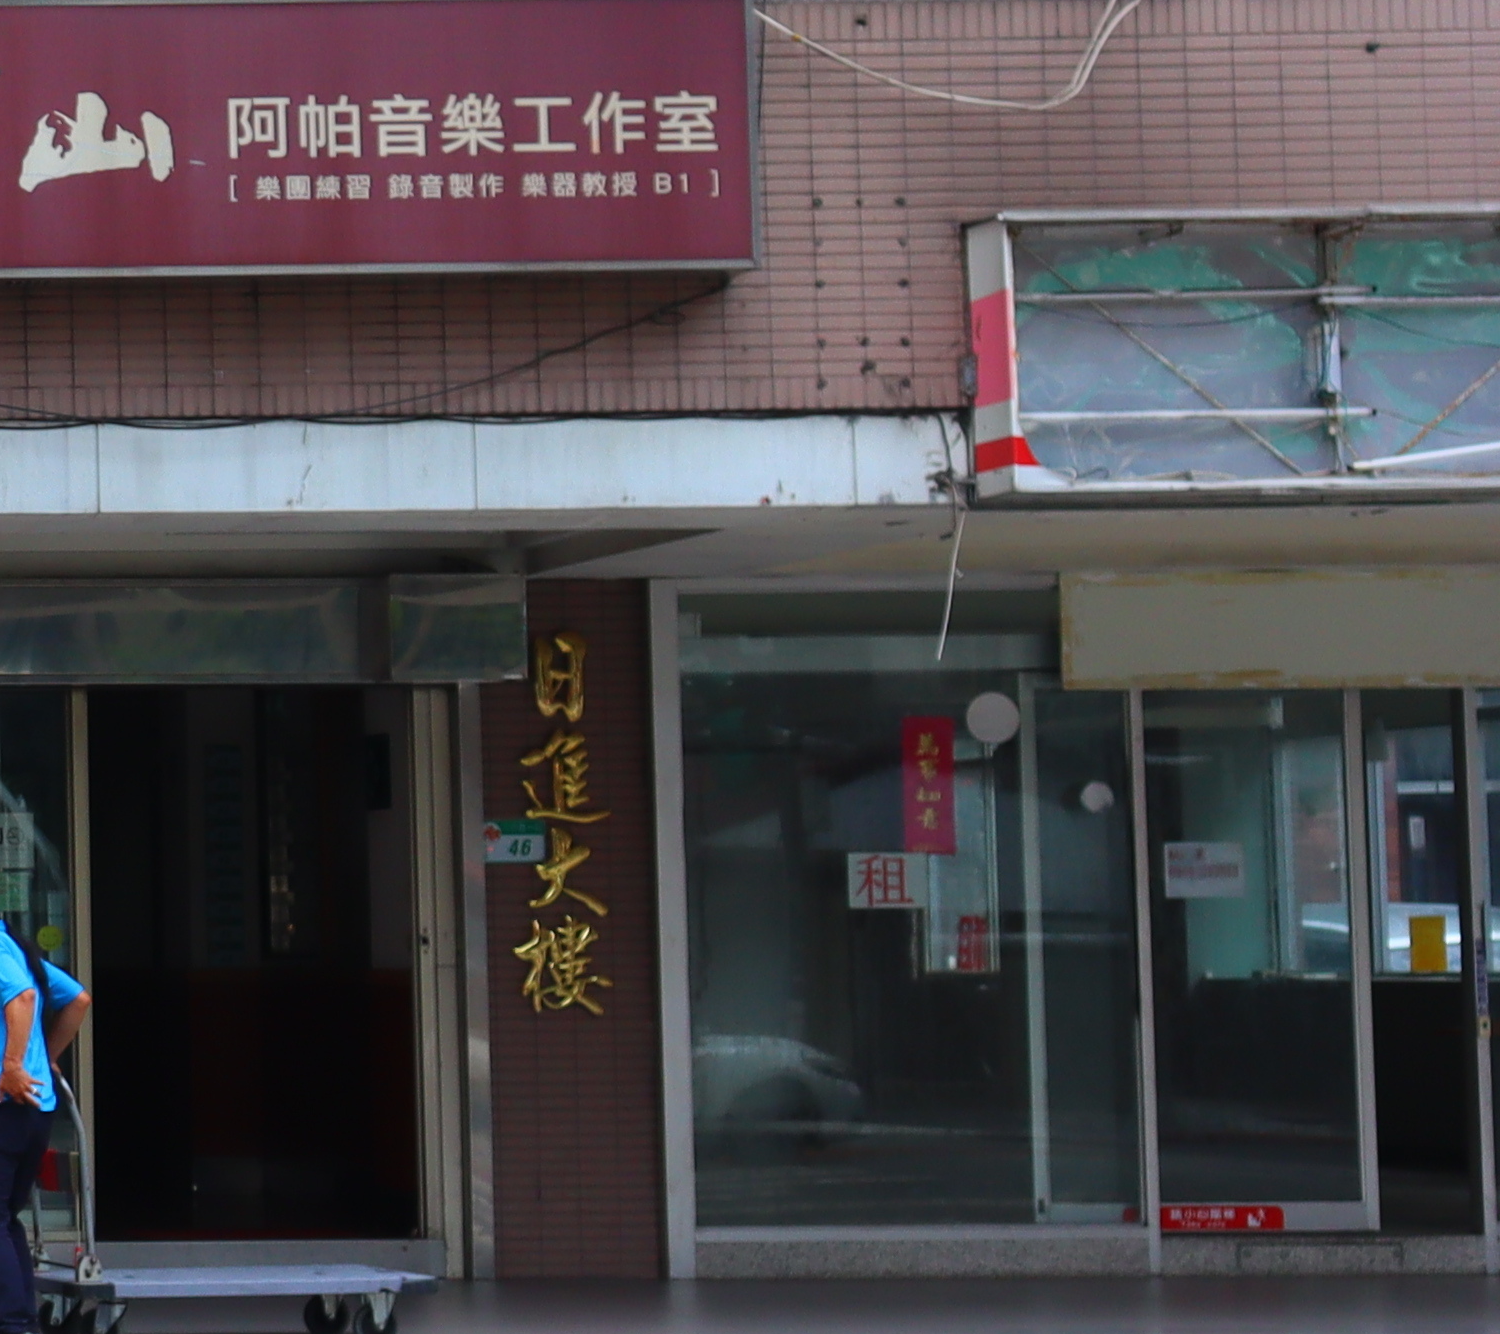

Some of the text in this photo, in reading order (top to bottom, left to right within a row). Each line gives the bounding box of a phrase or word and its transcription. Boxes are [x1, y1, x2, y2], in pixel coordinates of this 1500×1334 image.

[227, 90, 719, 160] 阿帕音樂工作室
[255, 175, 371, 202] 樂團練習
[388, 172, 506, 200] 錄音製作
[521, 170, 639, 199] 樂器教授
[653, 171, 691, 196] B1
[509, 840, 531, 856] 46
[513, 632, 612, 1017] 日進大樓
[855, 855, 914, 907] 租
